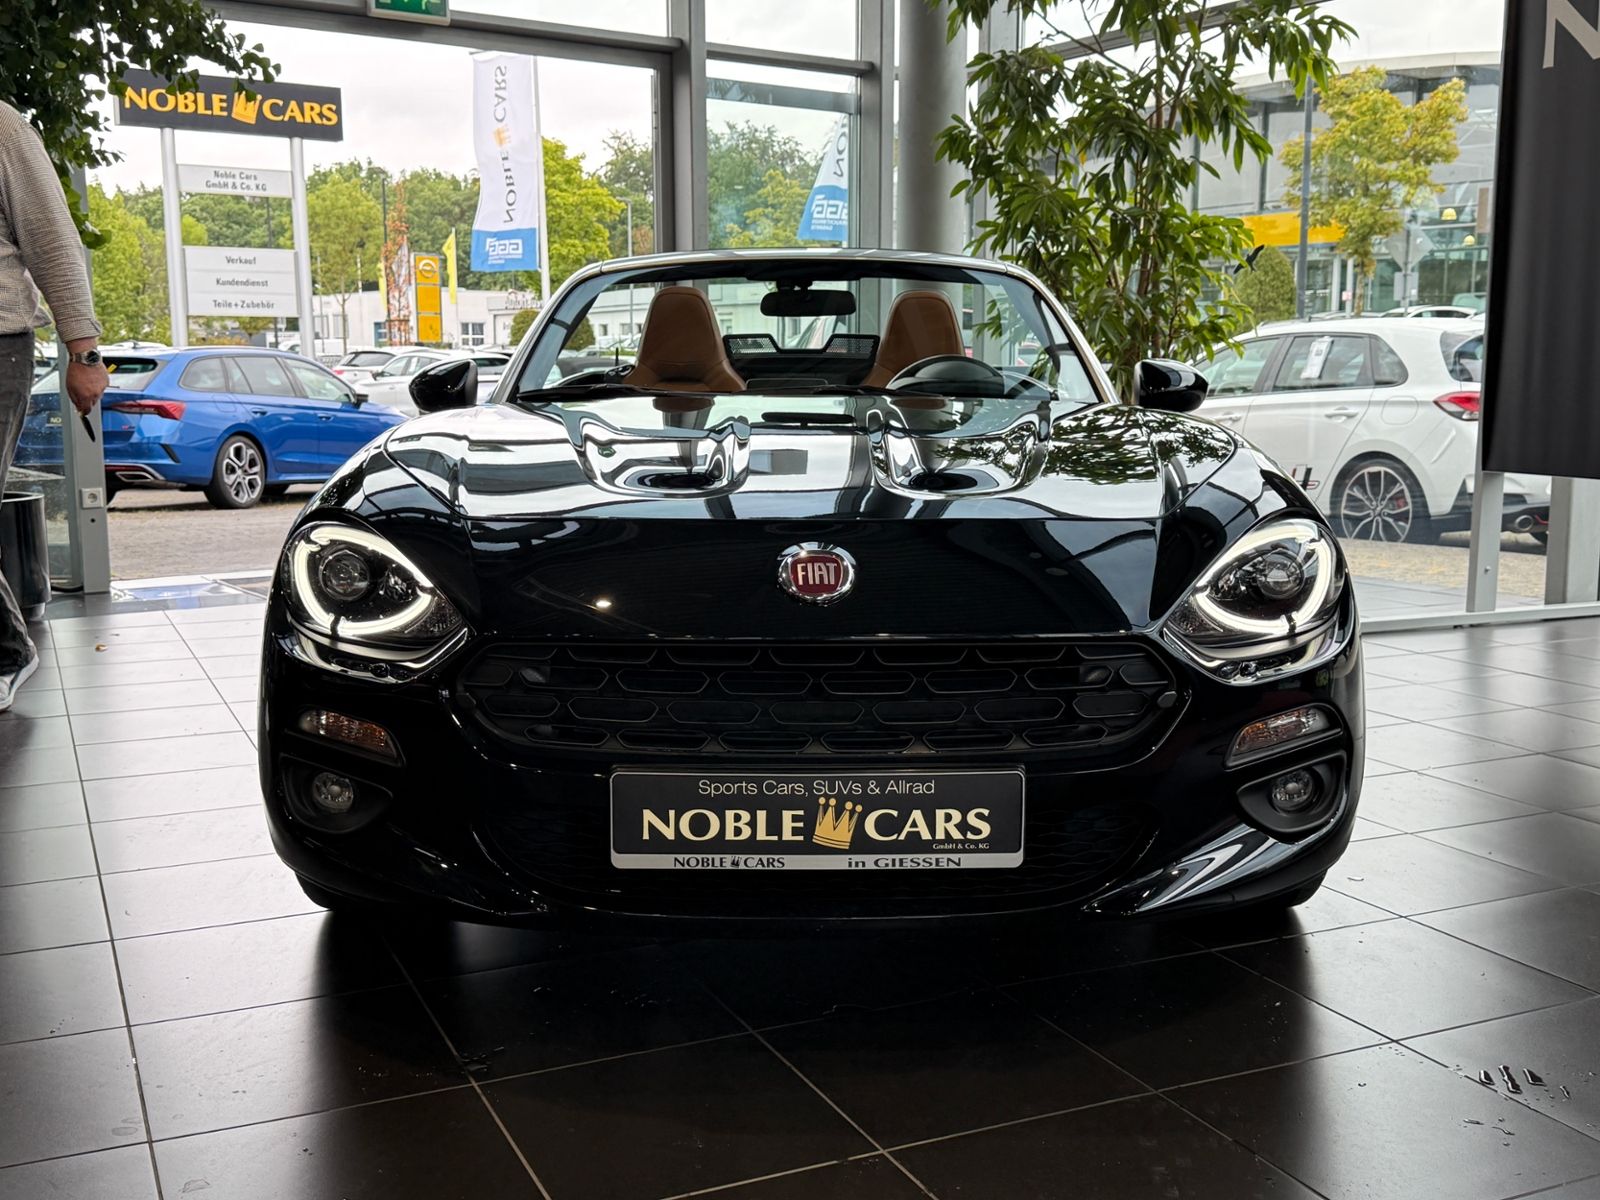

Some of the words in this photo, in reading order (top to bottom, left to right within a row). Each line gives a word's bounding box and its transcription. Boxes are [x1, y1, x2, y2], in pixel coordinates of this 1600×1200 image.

[124, 86, 228, 116] NOBLE
[262, 98, 338, 126] CARS
[213, 170, 236, 179] Noble
[239, 171, 258, 181] Cars
[205, 180, 229, 189] GmbH
[231, 181, 238, 190] &
[255, 183, 267, 191] KG
[225, 255, 257, 265] Verkauf
[215, 277, 269, 287] Kundendienst
[796, 562, 838, 586] FIAT
[698, 779, 758, 797] Sports
[762, 779, 809, 797] Cars,
[813, 779, 863, 795] SUVs
[866, 780, 881, 795] &
[885, 779, 935, 795] Allrad
[641, 808, 805, 842] NOBLE
[863, 807, 991, 841] CARS
[932, 842, 956, 850] GmbH
[964, 842, 977, 850] Co.
[673, 856, 727, 868] NOBLE
[743, 856, 785, 869] CARS
[847, 857, 866, 869] in
[873, 856, 962, 868] GIESSEN
